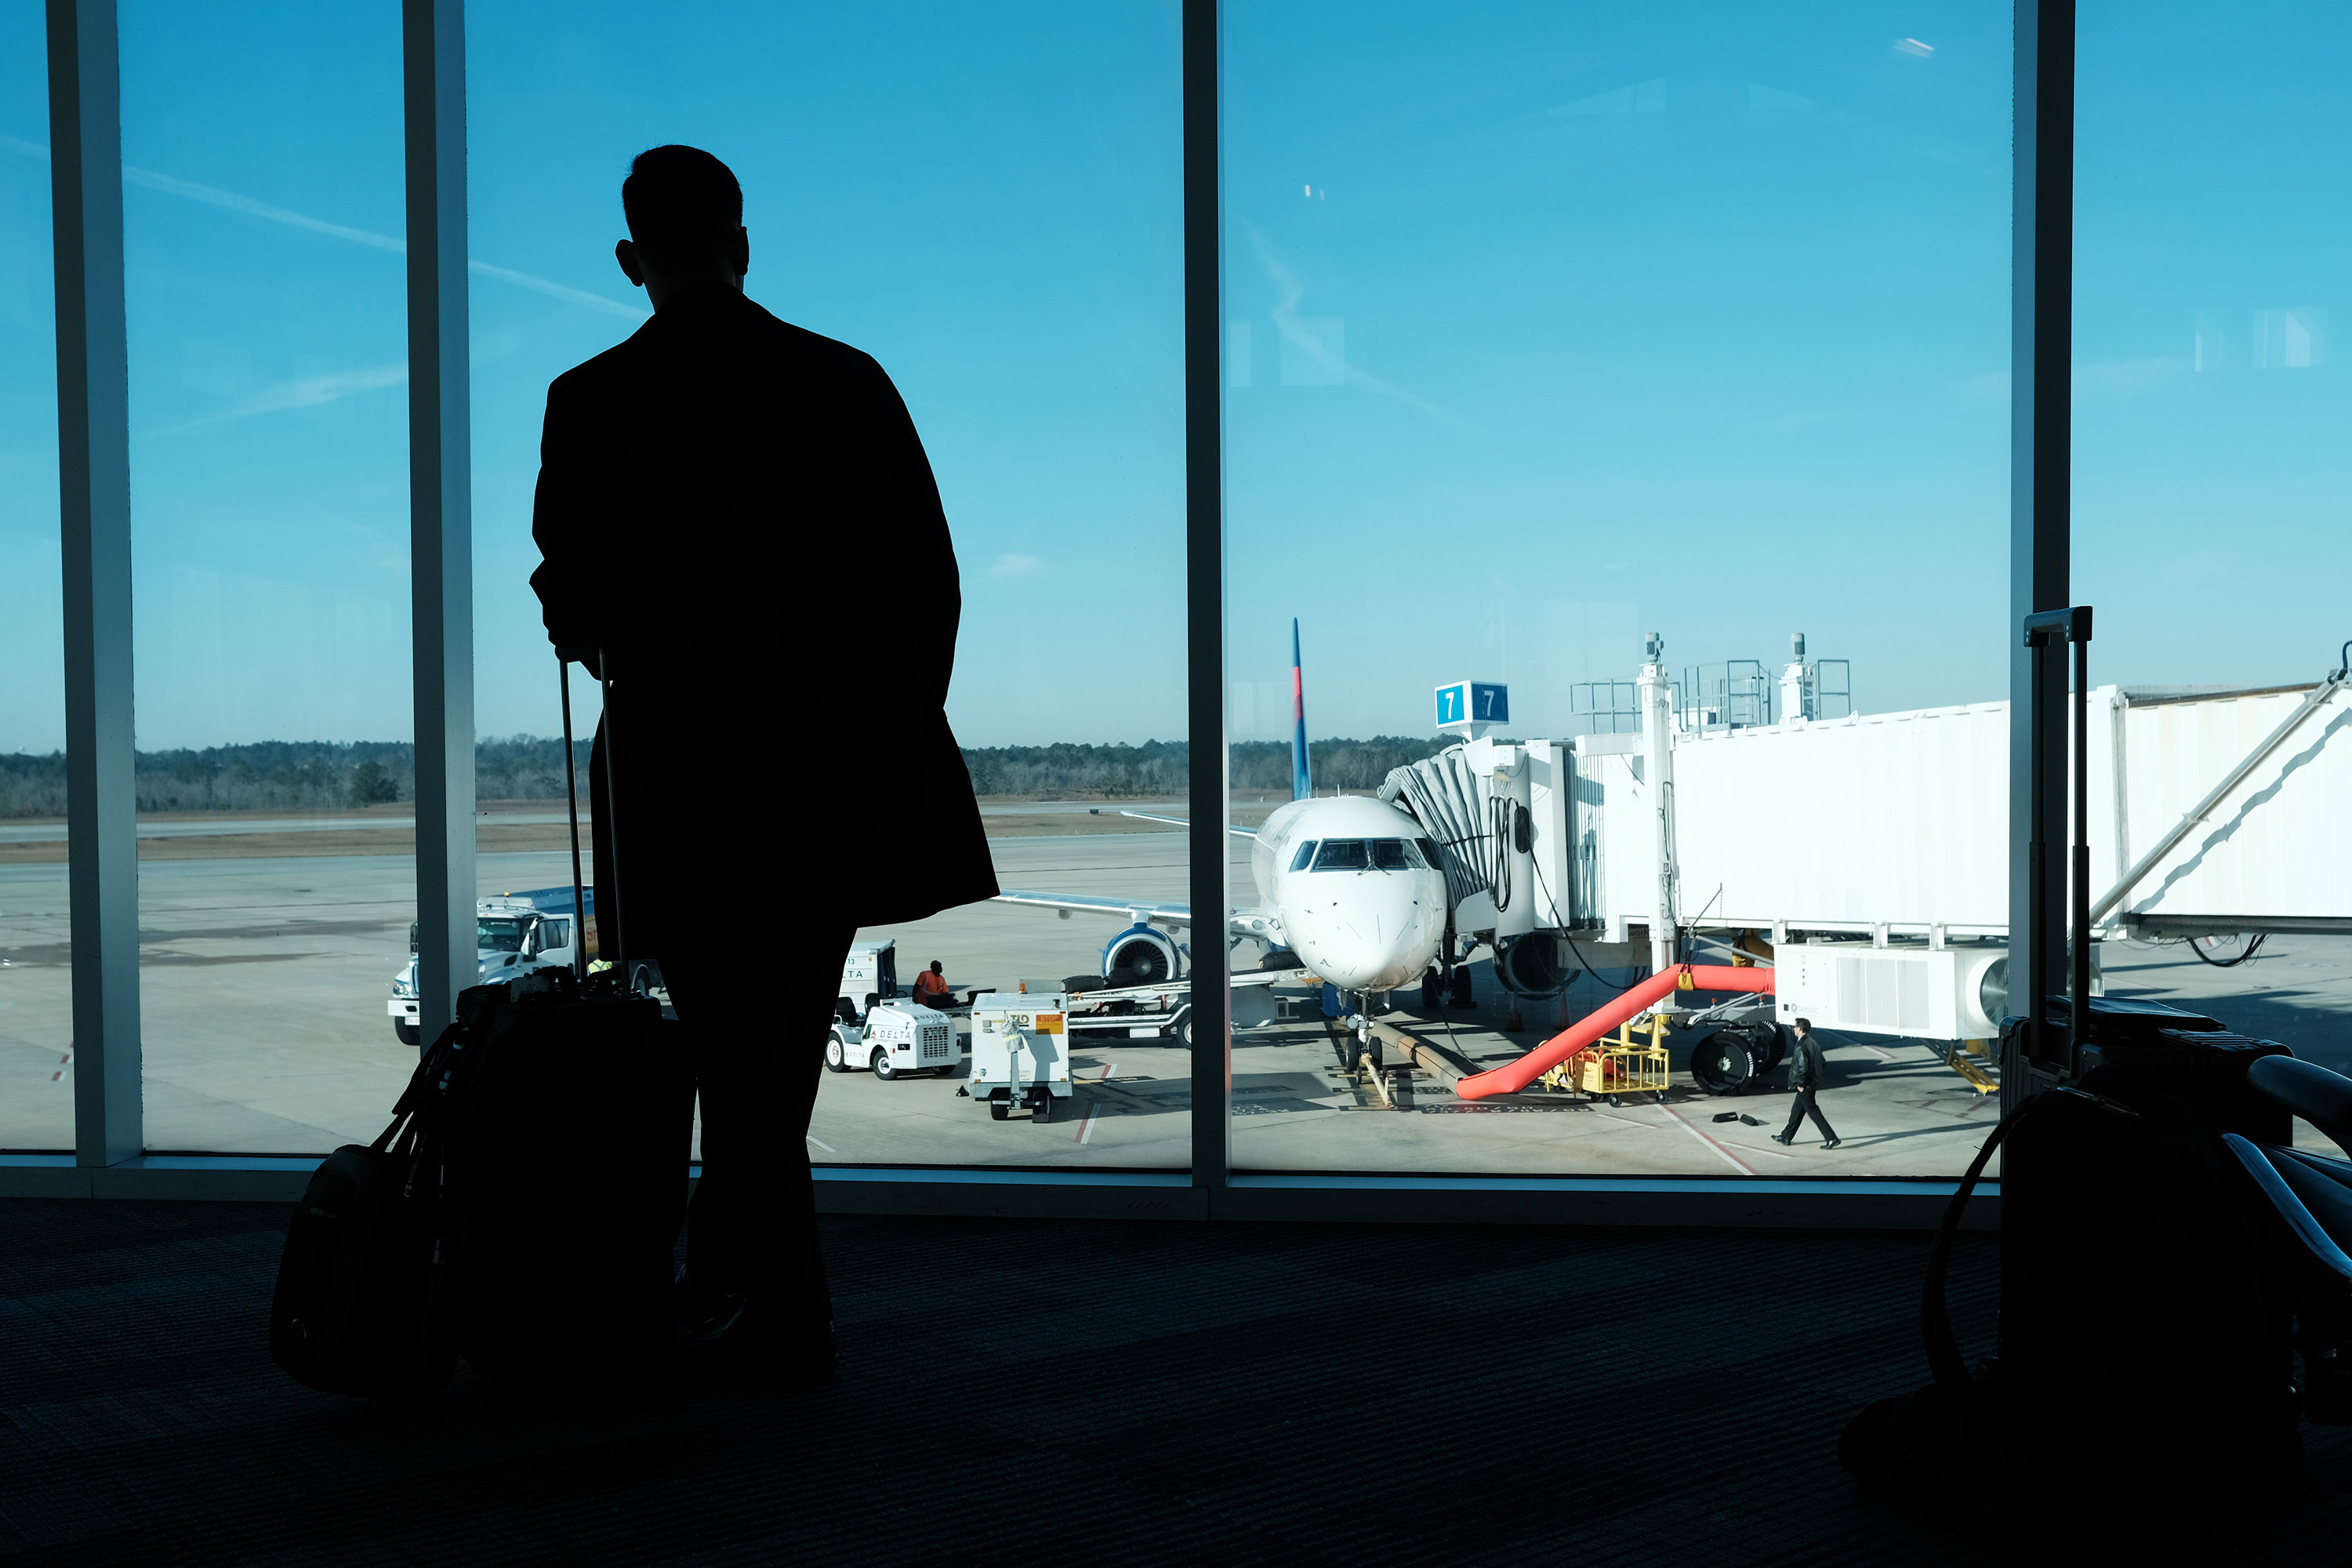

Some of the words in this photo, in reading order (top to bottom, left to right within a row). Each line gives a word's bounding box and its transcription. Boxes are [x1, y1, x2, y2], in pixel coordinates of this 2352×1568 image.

[1445, 691, 1454, 719] 7
[1484, 691, 1494, 717] 7
[843, 970, 863, 978] TA
[880, 1029, 910, 1039] DELTA
